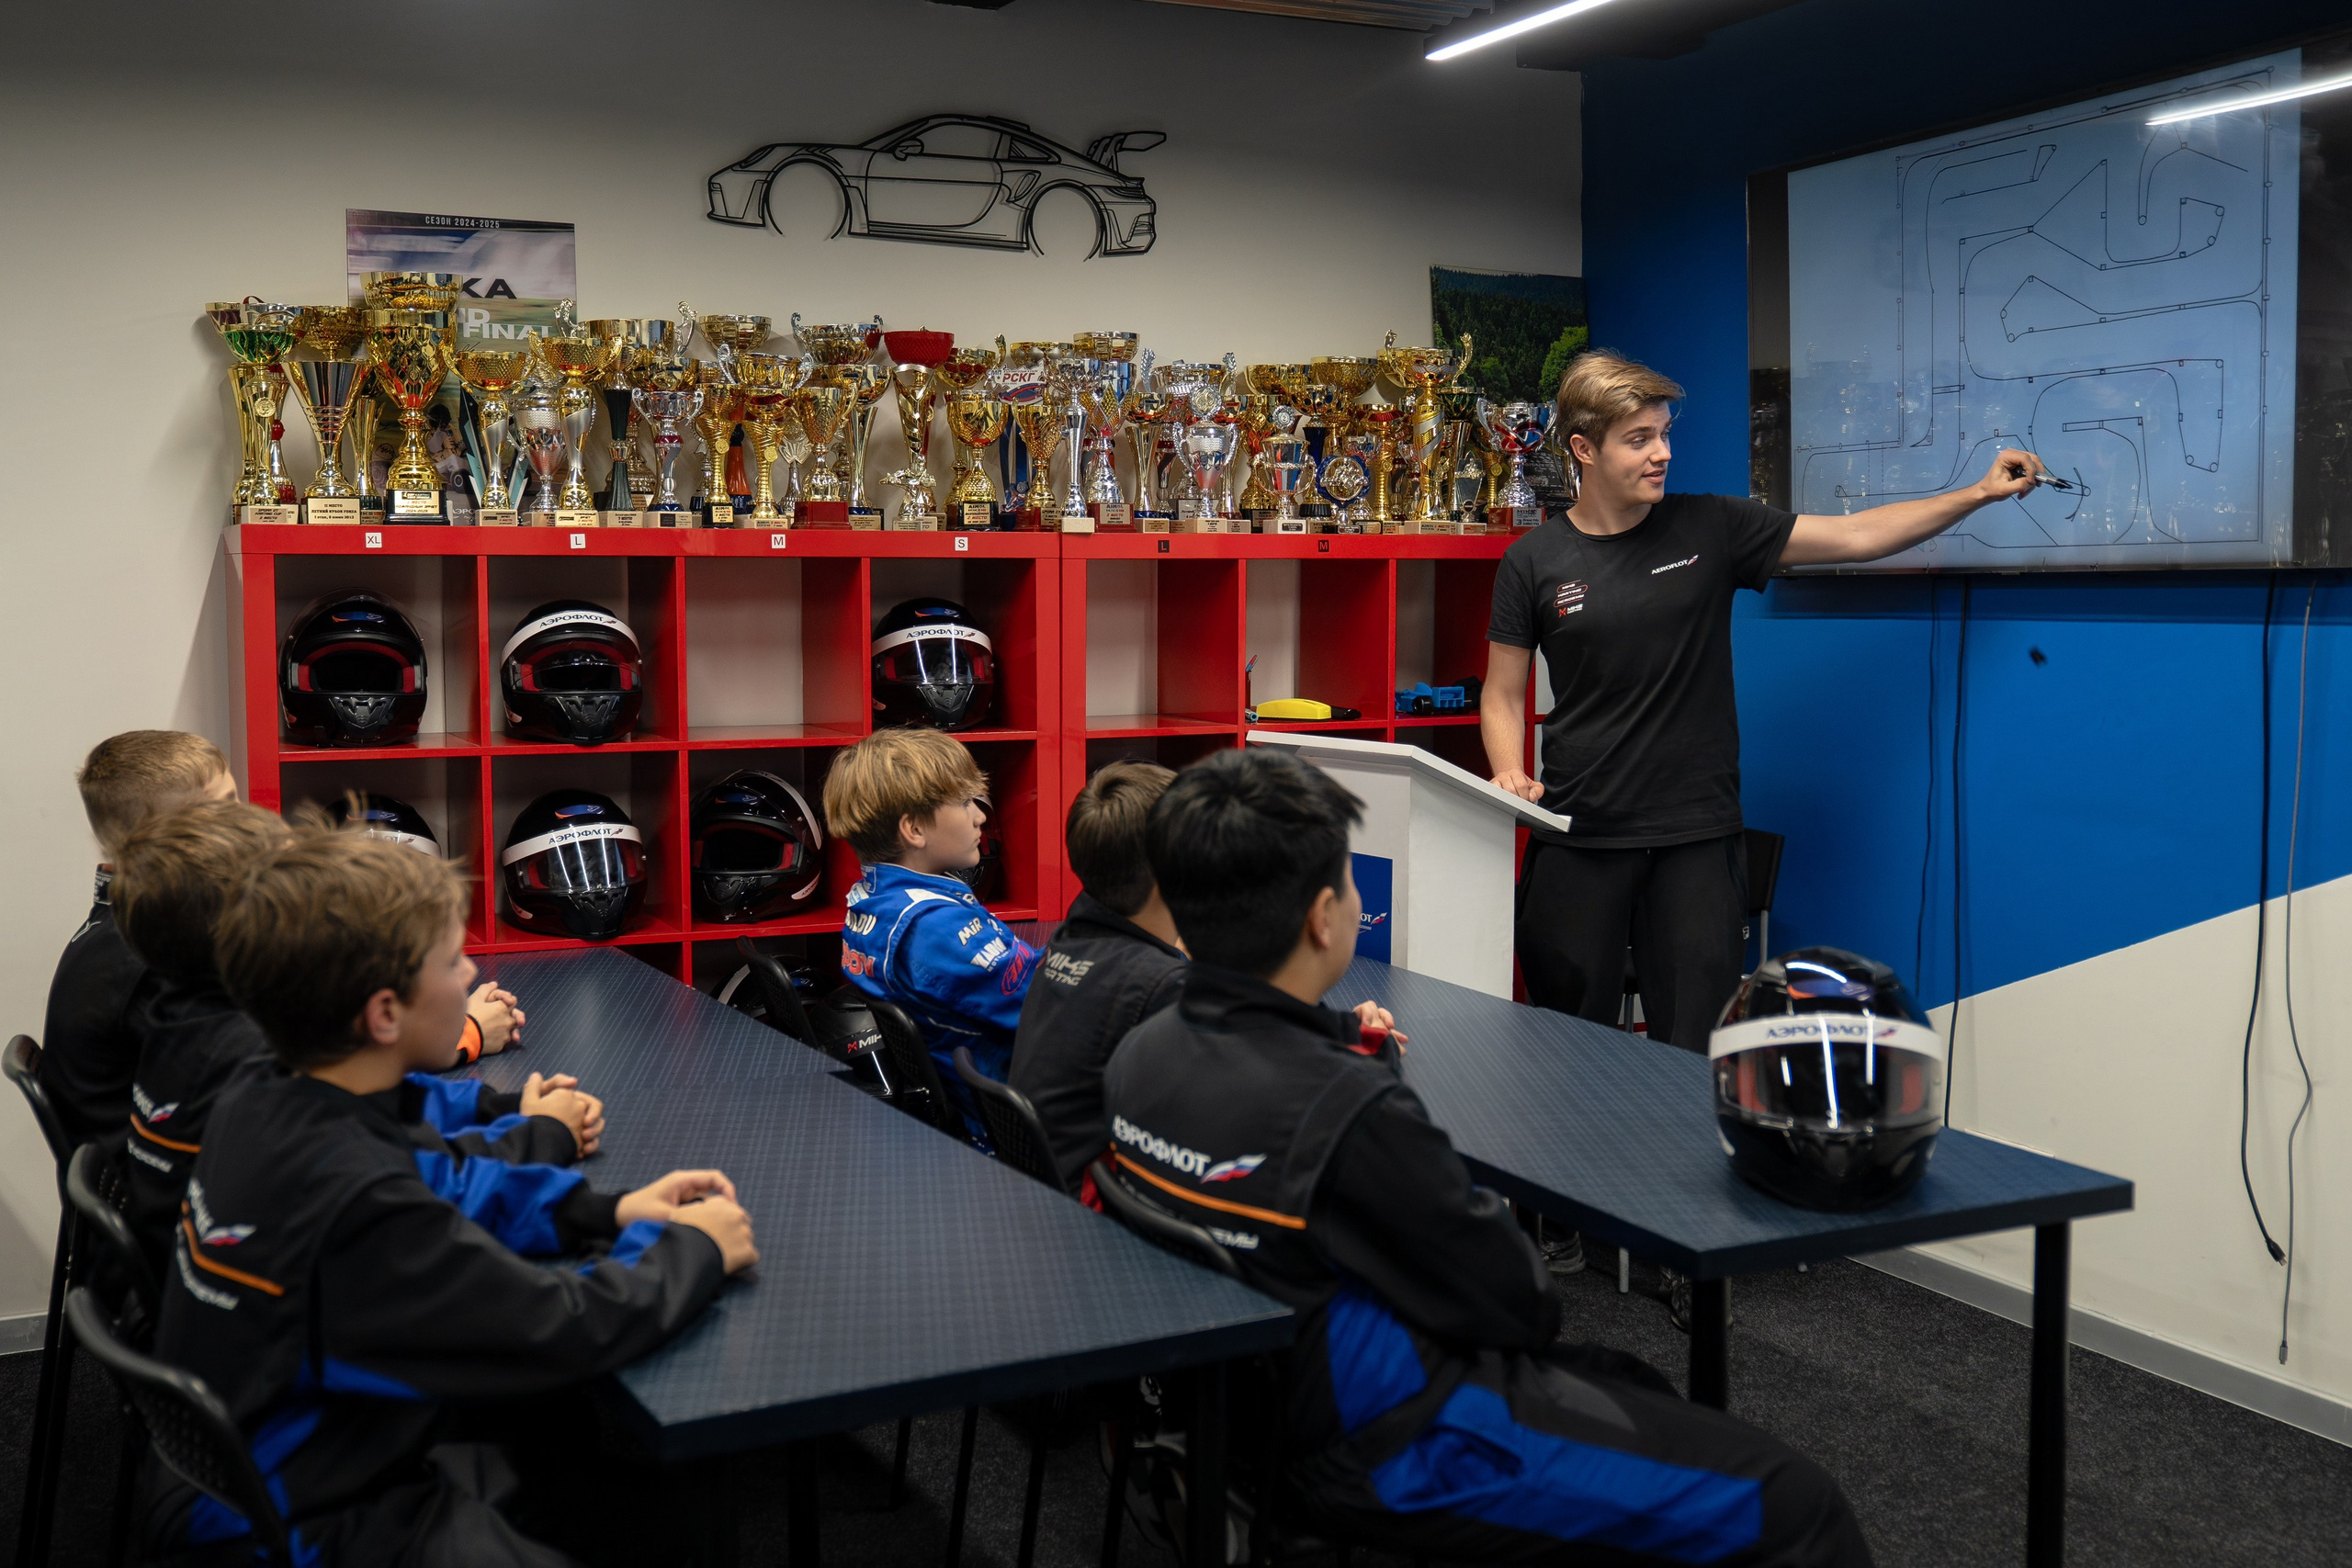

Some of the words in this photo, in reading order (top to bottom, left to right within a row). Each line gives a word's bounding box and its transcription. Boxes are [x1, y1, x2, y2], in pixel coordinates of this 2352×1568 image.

[425, 216, 451, 225] СЕЗОН
[455, 218, 500, 229] 2024-2025
[1002, 372, 1035, 383] РСКГ
[368, 536, 380, 544] XL
[575, 536, 582, 546] L
[774, 536, 784, 546] M
[958, 539, 966, 548] S
[1161, 541, 1168, 551] L
[1319, 541, 1329, 550] M
[1651, 558, 1688, 575] AEROFLOT
[540, 615, 604, 628] АЭРОФЛОТ
[906, 628, 965, 639] АЭРОФЛОТ
[548, 829, 612, 845] АЭРОФЛОТ
